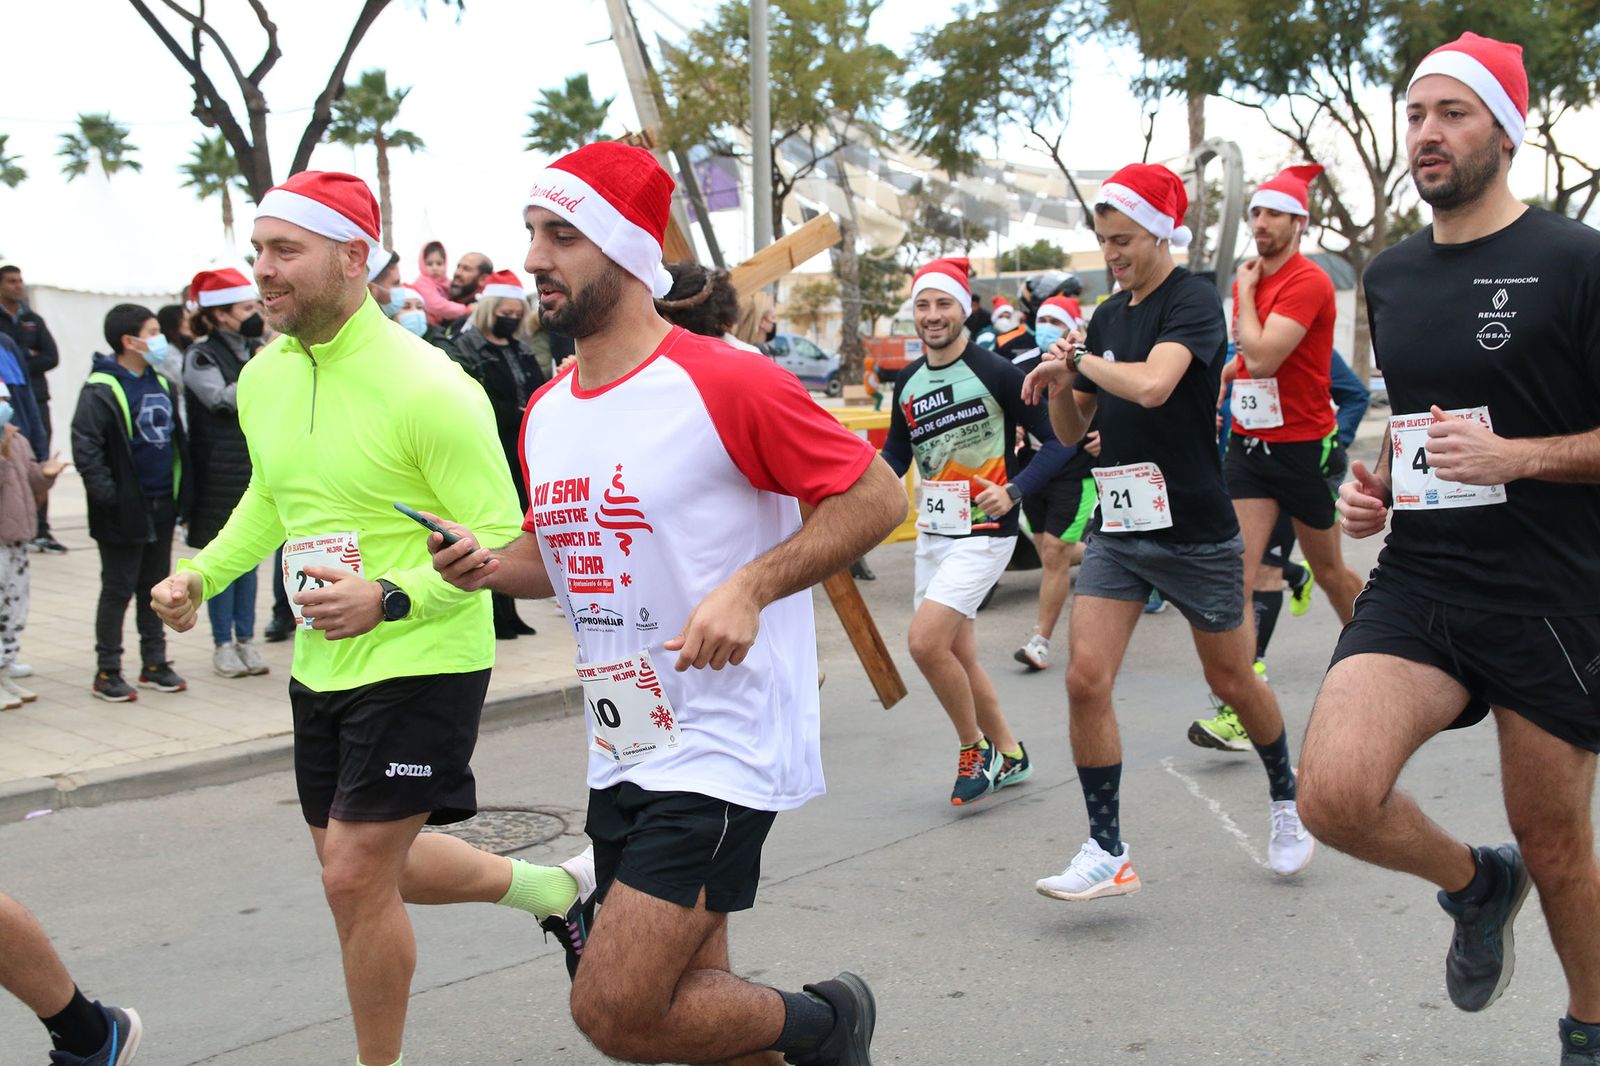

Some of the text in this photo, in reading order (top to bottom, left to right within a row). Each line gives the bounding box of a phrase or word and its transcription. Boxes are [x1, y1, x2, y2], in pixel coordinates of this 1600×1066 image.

[1494, 276, 1539, 285] AUTOMOCIÓN
[1477, 311, 1518, 319] RENAULT
[912, 391, 949, 416] TRAIL
[1241, 395, 1258, 410] 53
[924, 421, 935, 432] DE
[960, 423, 979, 437] 350
[533, 477, 591, 508] XII SAN
[1110, 489, 1133, 509] 21
[926, 498, 946, 514] 54
[534, 507, 589, 529] SILVESTRE
[587, 531, 603, 547] DE
[566, 551, 605, 575] NÍJAR
[624, 660, 634, 668] DE
[385, 762, 433, 778] Joma
